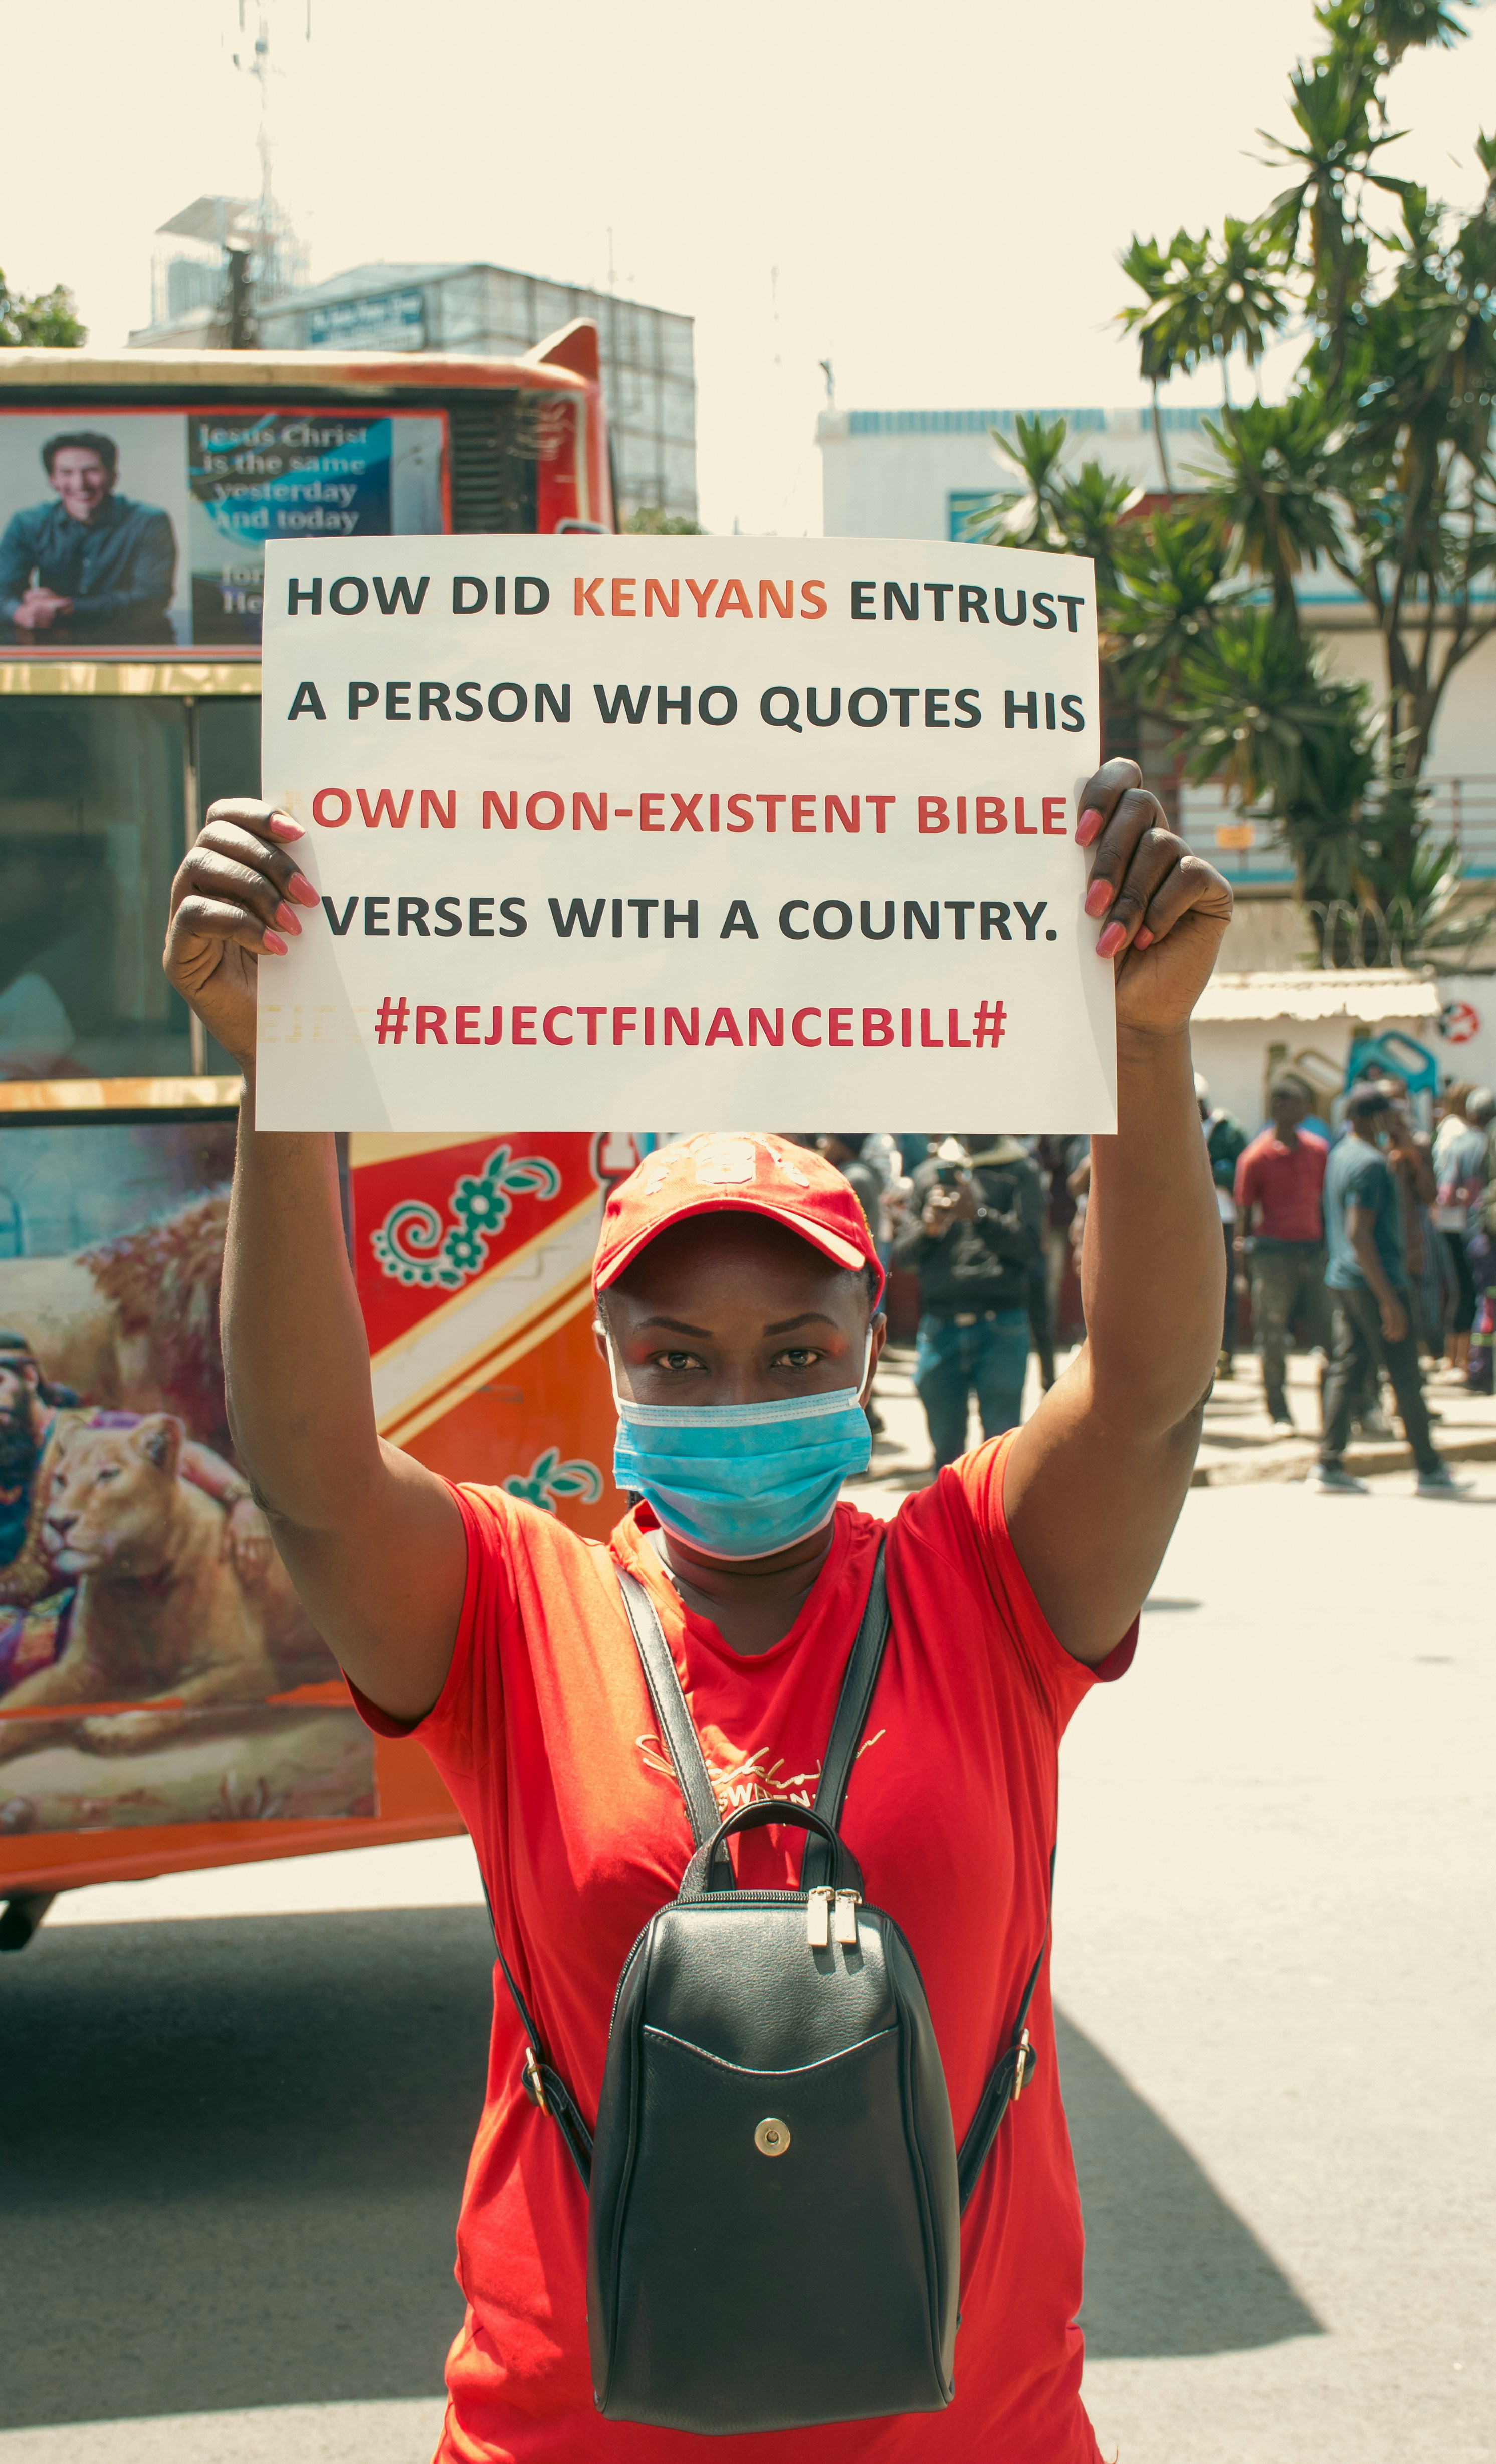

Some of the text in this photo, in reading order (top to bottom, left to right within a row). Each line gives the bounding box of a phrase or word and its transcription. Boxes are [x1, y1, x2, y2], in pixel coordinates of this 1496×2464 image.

[200, 424, 368, 448] Jesus Christ
[202, 451, 365, 475] is the same
[213, 481, 358, 508] yesterday
[216, 506, 360, 534] and today
[221, 563, 264, 586] for
[223, 590, 263, 614] He
[288, 577, 1084, 633] HOW DID KENYANS ENTRUST
[288, 682, 1084, 733] A PERSON WHO QUOTES HIS
[313, 788, 1067, 835] OWN NON-EXISTENT BIBLE
[321, 896, 1056, 941] VERSES WITH A COUNTRY.
[375, 997, 1007, 1048] #REJECTFINANCEBILL#
